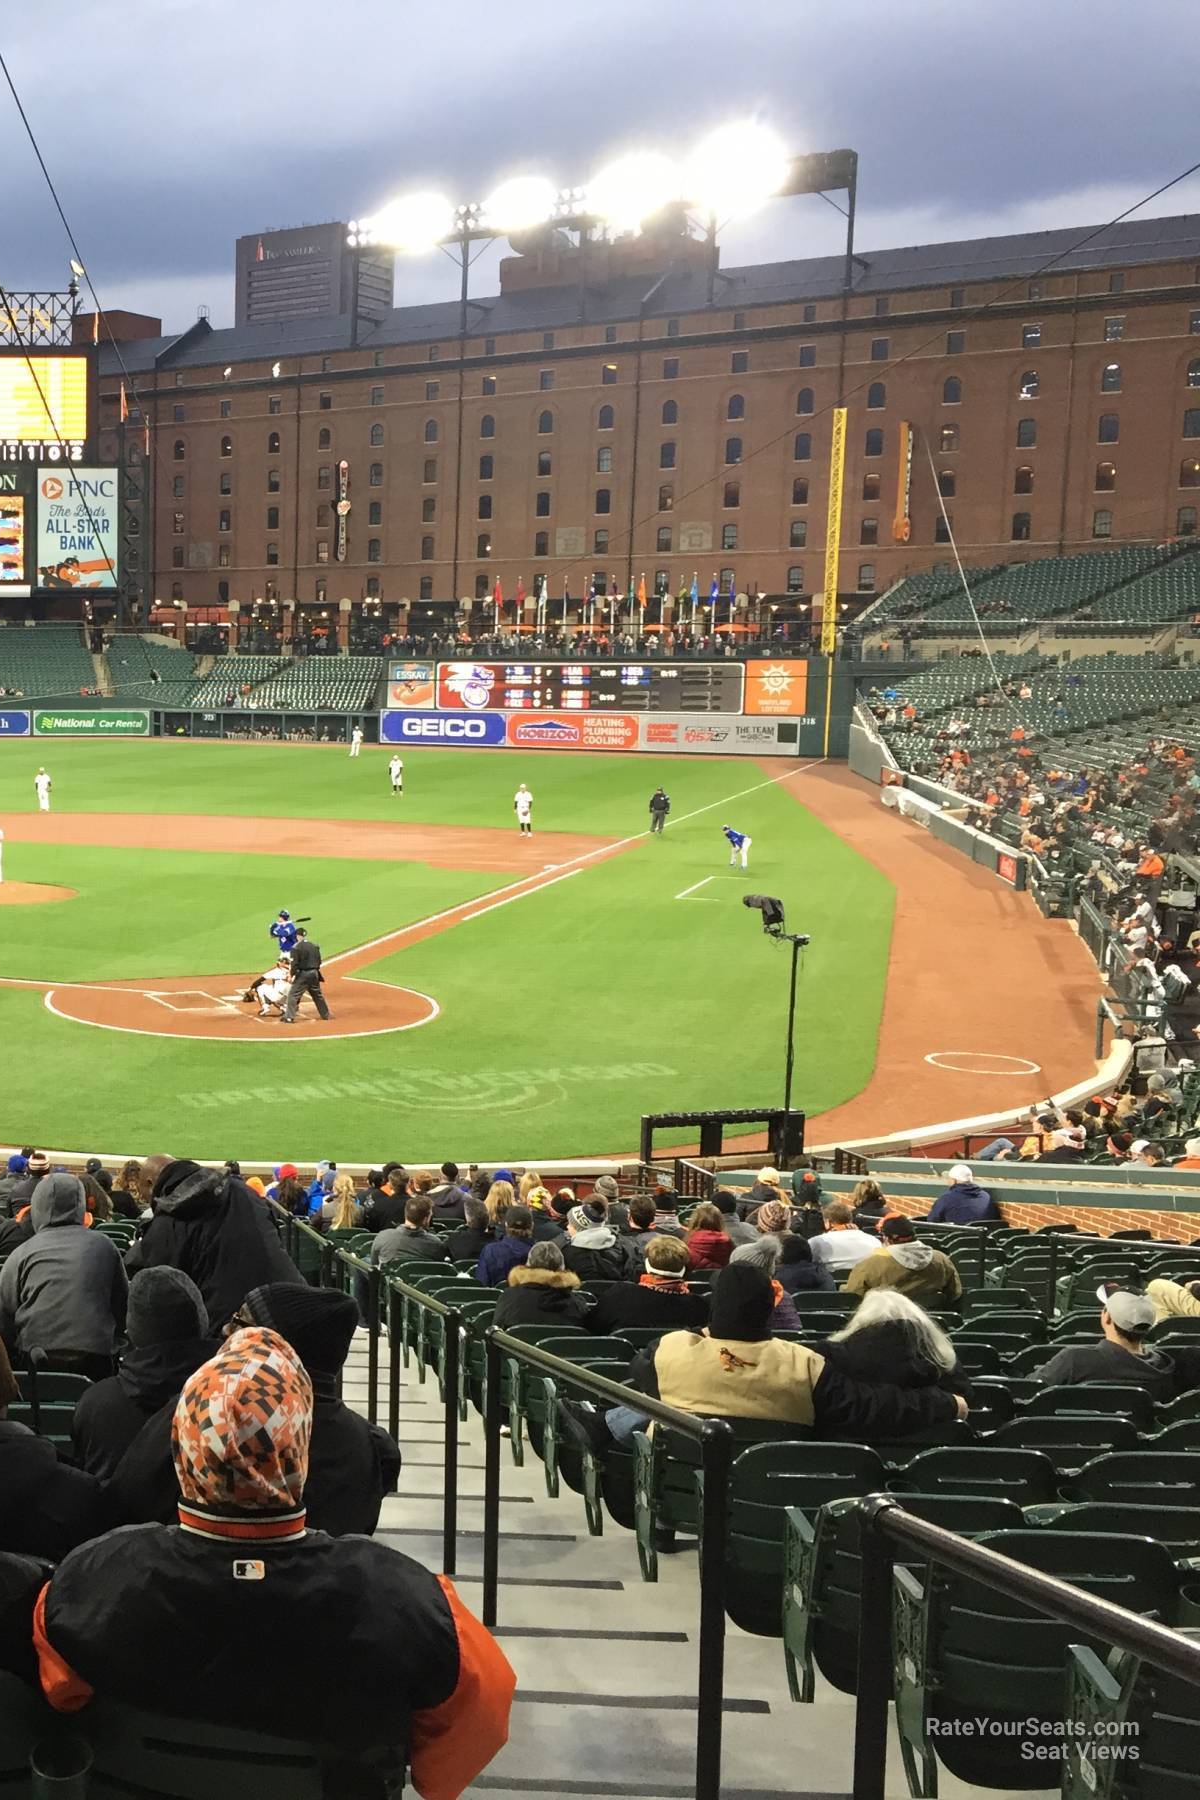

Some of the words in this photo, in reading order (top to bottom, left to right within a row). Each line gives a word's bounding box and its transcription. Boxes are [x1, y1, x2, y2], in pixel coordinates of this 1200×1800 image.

[68, 480, 114, 498] PNC
[49, 504, 71, 517] The
[46, 519, 109, 533] ALL-STAR
[60, 536, 95, 550] BANK
[396, 671, 427, 680] ESSKAY
[53, 718, 94, 728] National
[99, 719, 113, 728] Car
[115, 719, 142, 728] Rental
[402, 718, 486, 738] GEICO
[583, 718, 624, 727] HEATING
[518, 729, 578, 740] HORIZON
[583, 727, 632, 736] PLUMBING
[753, 727, 774, 736] TEAM
[583, 737, 624, 745] COOLING
[177, 1078, 419, 1108] OPENING
[431, 1062, 677, 1091] WEEKEND
